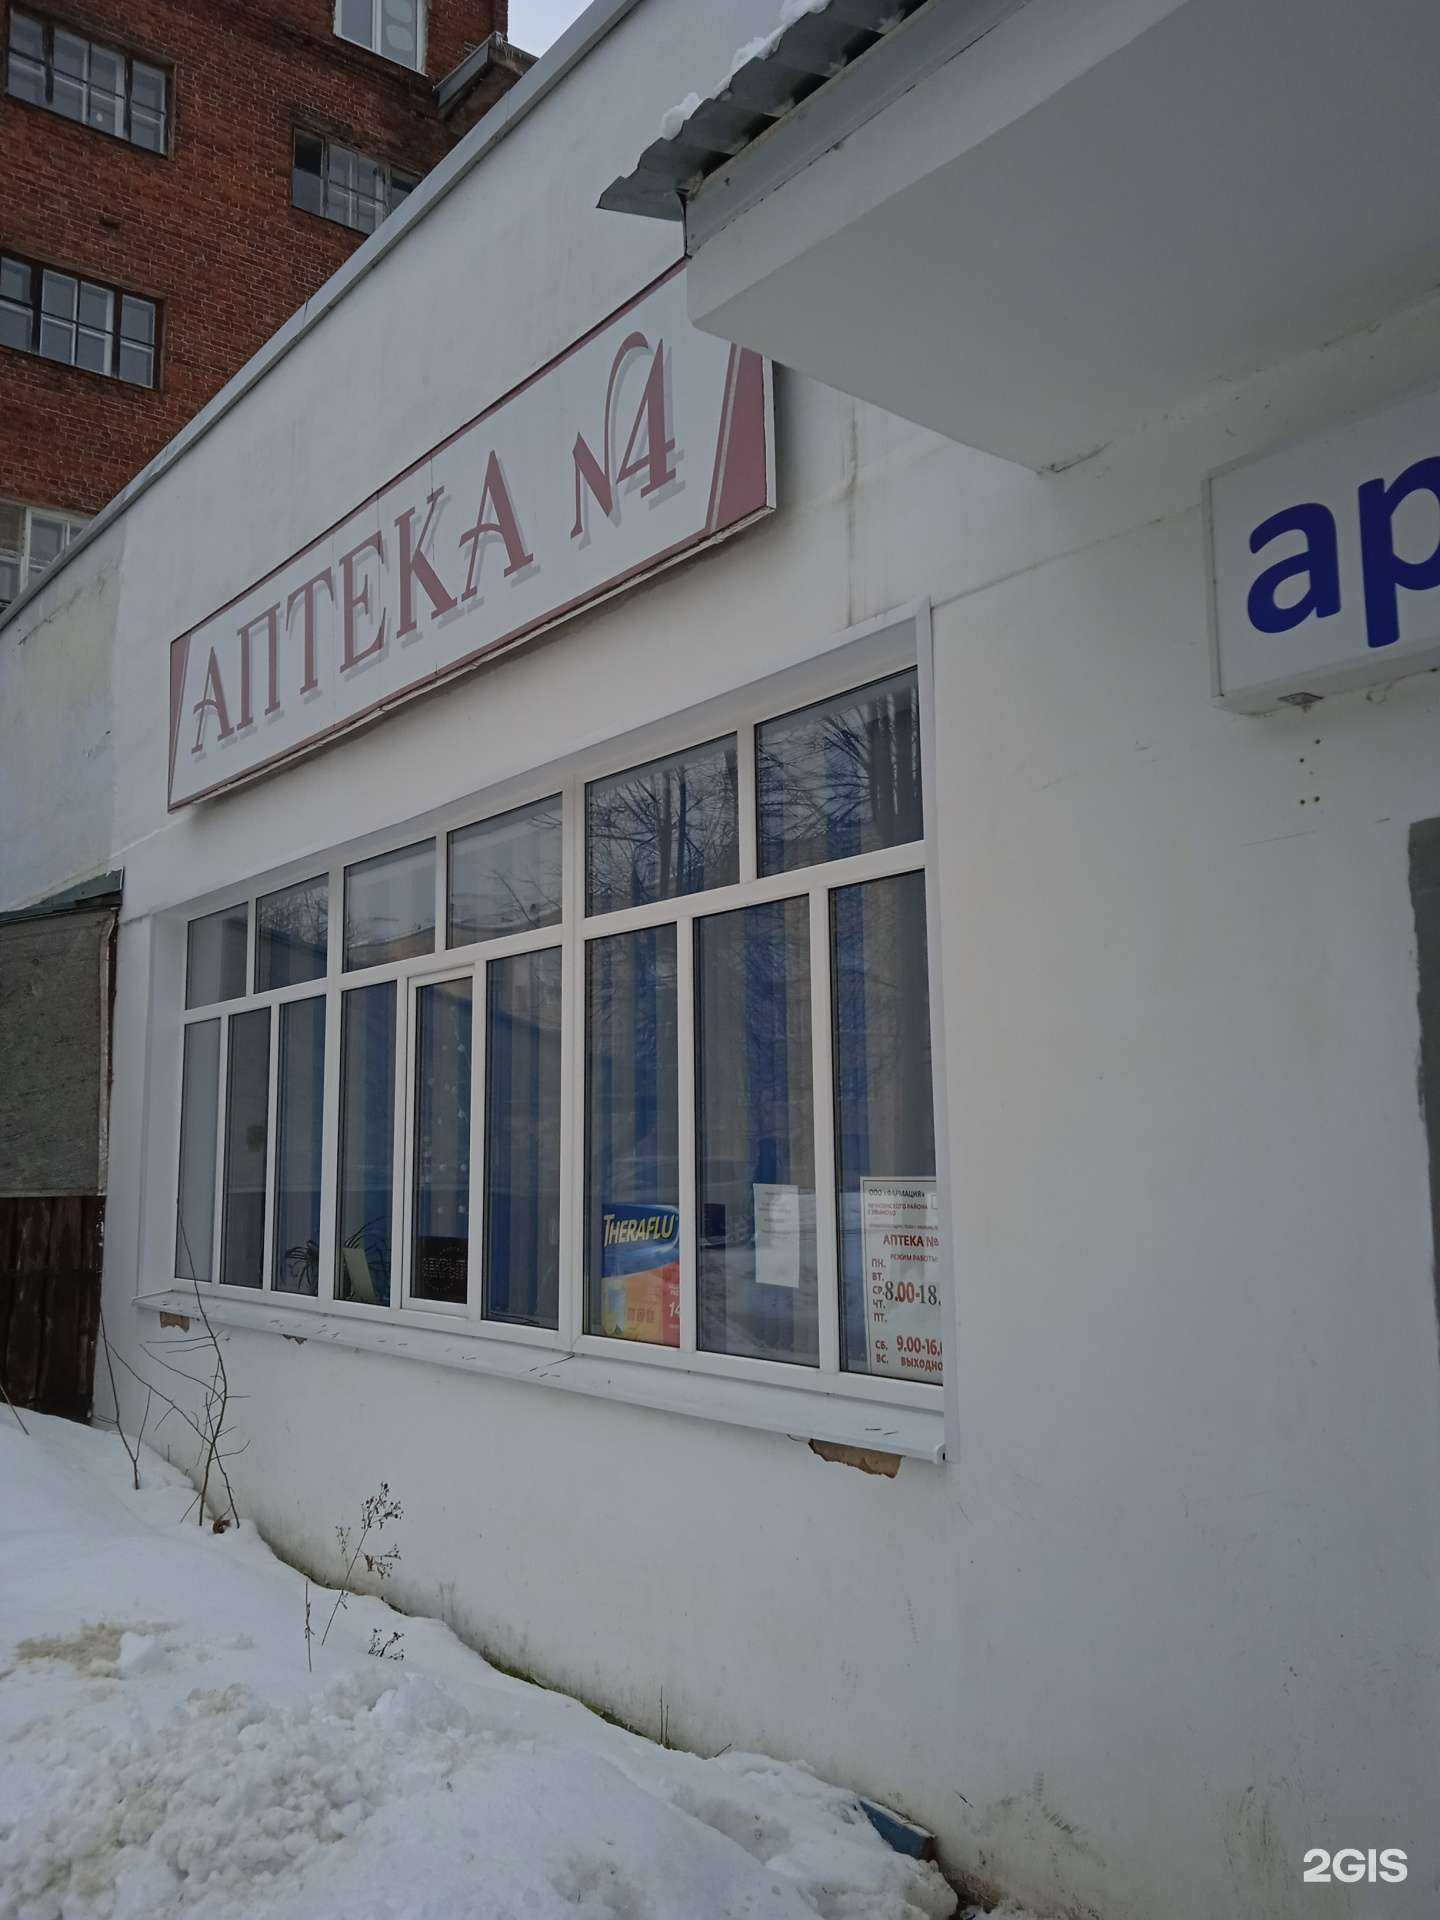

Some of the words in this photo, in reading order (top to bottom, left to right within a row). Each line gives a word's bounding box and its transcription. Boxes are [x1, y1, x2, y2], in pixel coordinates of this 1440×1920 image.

[191, 450, 534, 754] АПТЕКА
[883, 1234, 924, 1247] АПТЕКА
[872, 1258, 886, 1268] ПН.
[872, 1272, 884, 1281] ВТ.
[872, 1286, 885, 1295] СР.
[872, 1299, 886, 1309] ЧТ.
[874, 1312, 888, 1323] ПТ.
[876, 1353, 889, 1364] ВС.
